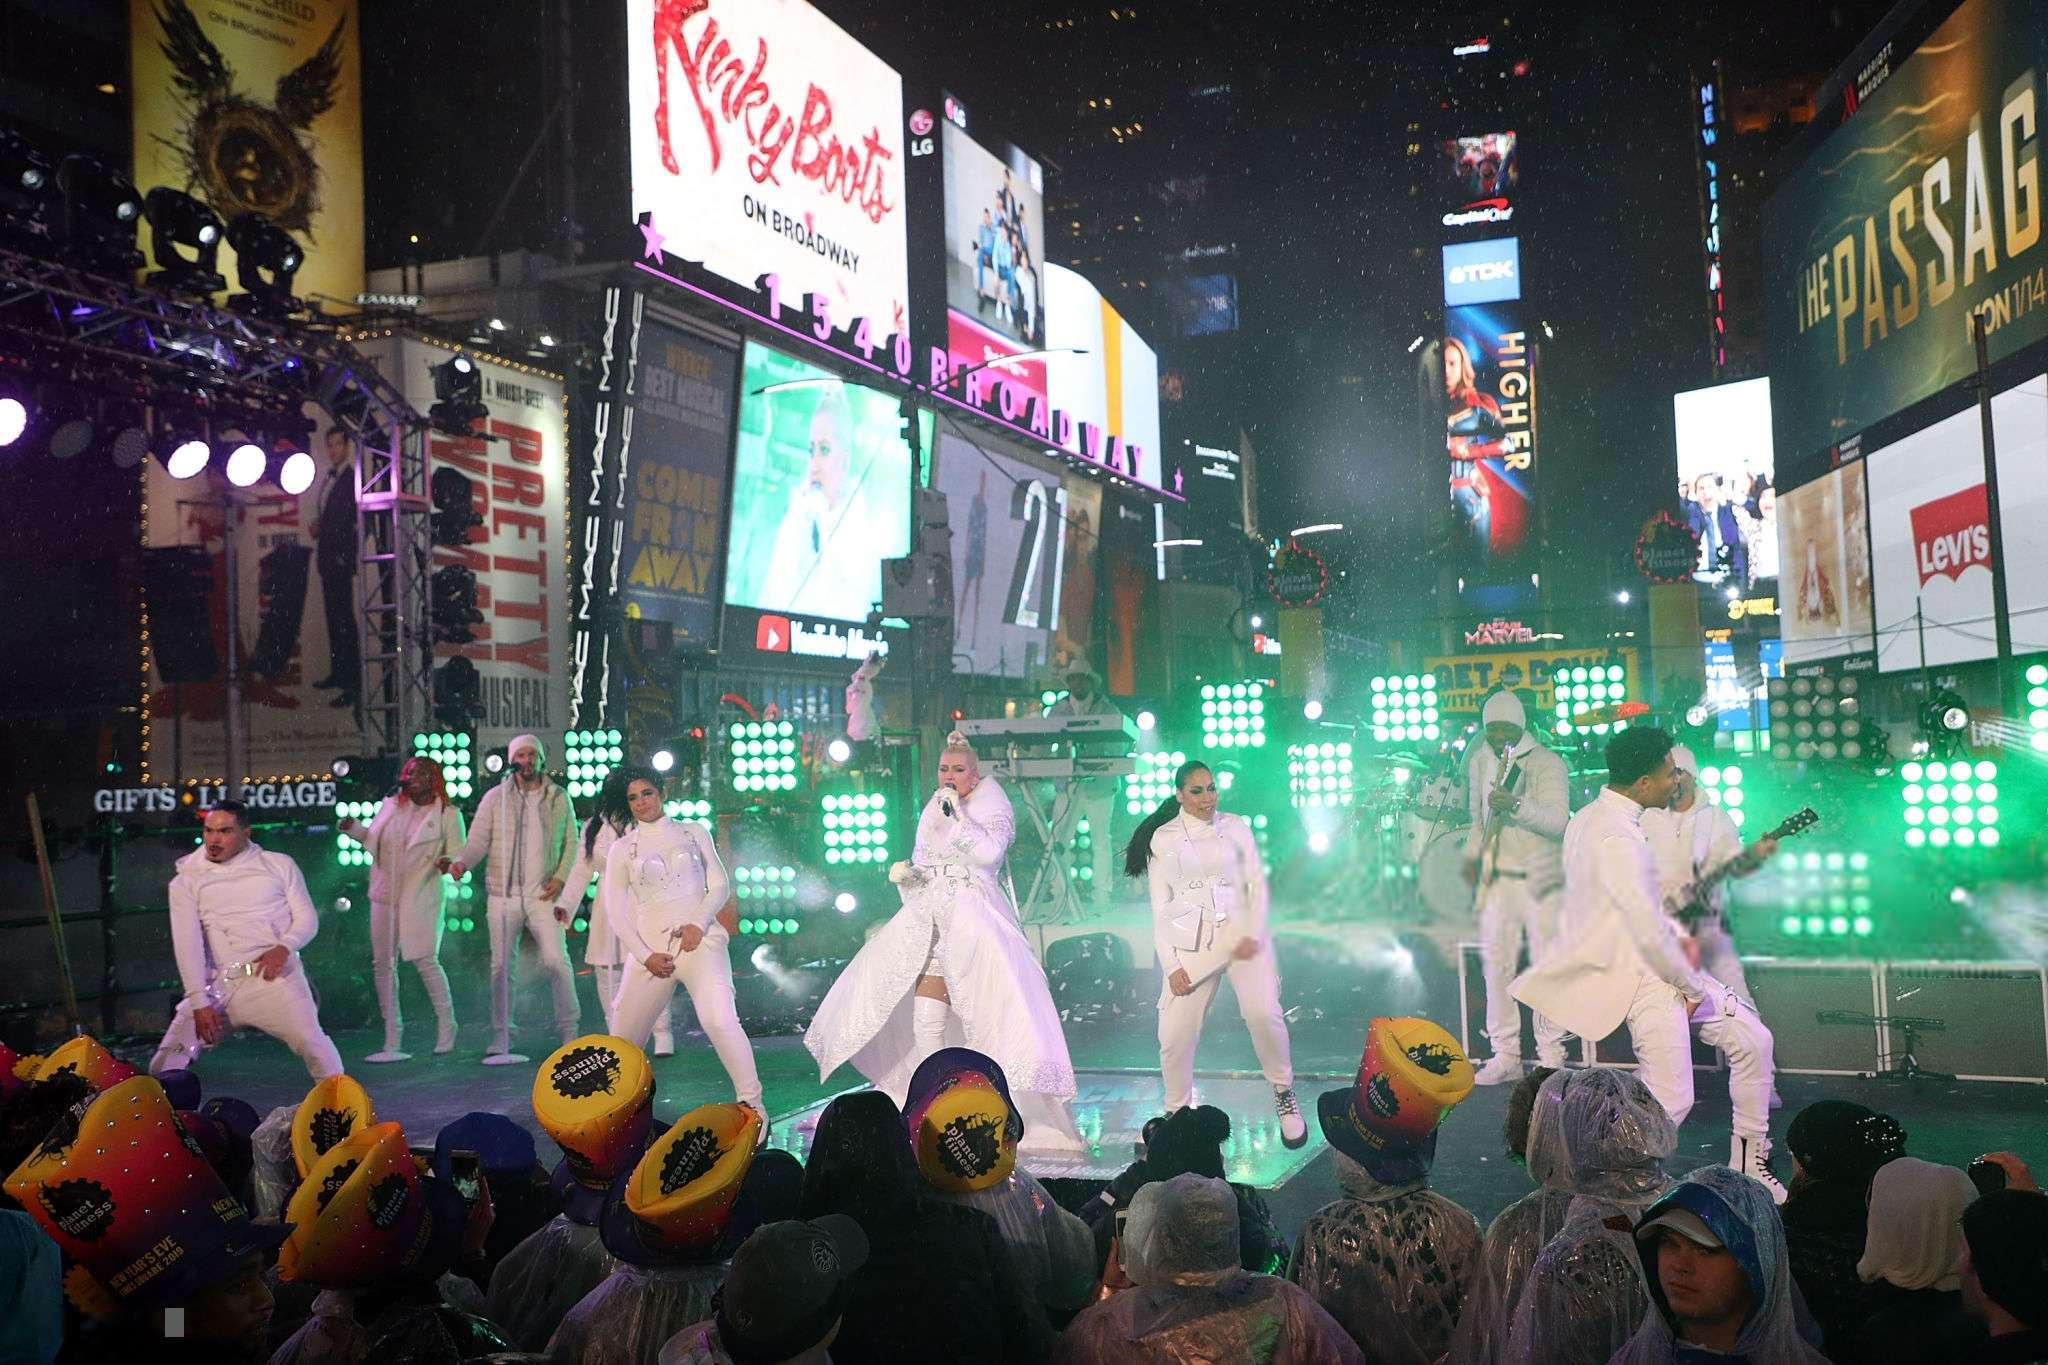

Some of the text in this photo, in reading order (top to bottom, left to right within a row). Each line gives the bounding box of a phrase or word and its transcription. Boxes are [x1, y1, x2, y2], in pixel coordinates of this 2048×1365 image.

[653, 0, 894, 224] Kinky Boots
[911, 138, 935, 157] LG
[743, 194, 861, 273] ON BROADWAY
[1462, 260, 1514, 282] TDK
[1966, 287, 2011, 345] MON
[765, 272, 1143, 478] 1540 BROADWAY
[1497, 331, 1532, 472] HIGHER
[491, 418, 551, 675] PRETTY
[1008, 479, 1068, 631] 21
[627, 545, 713, 594] AWAY
[1464, 627, 1537, 645] MARVEL
[1434, 662, 1494, 691] GET
[94, 786, 178, 813] GIFTS
[554, 1051, 601, 1082] fitness
[567, 1052, 613, 1084] planet
[945, 1137, 977, 1177] fitness
[946, 1126, 981, 1165] planet
[58, 1199, 96, 1232] planet
[67, 1201, 113, 1235] fitness
[152, 1235, 178, 1258] EVE
[162, 1245, 185, 1267] 2019
